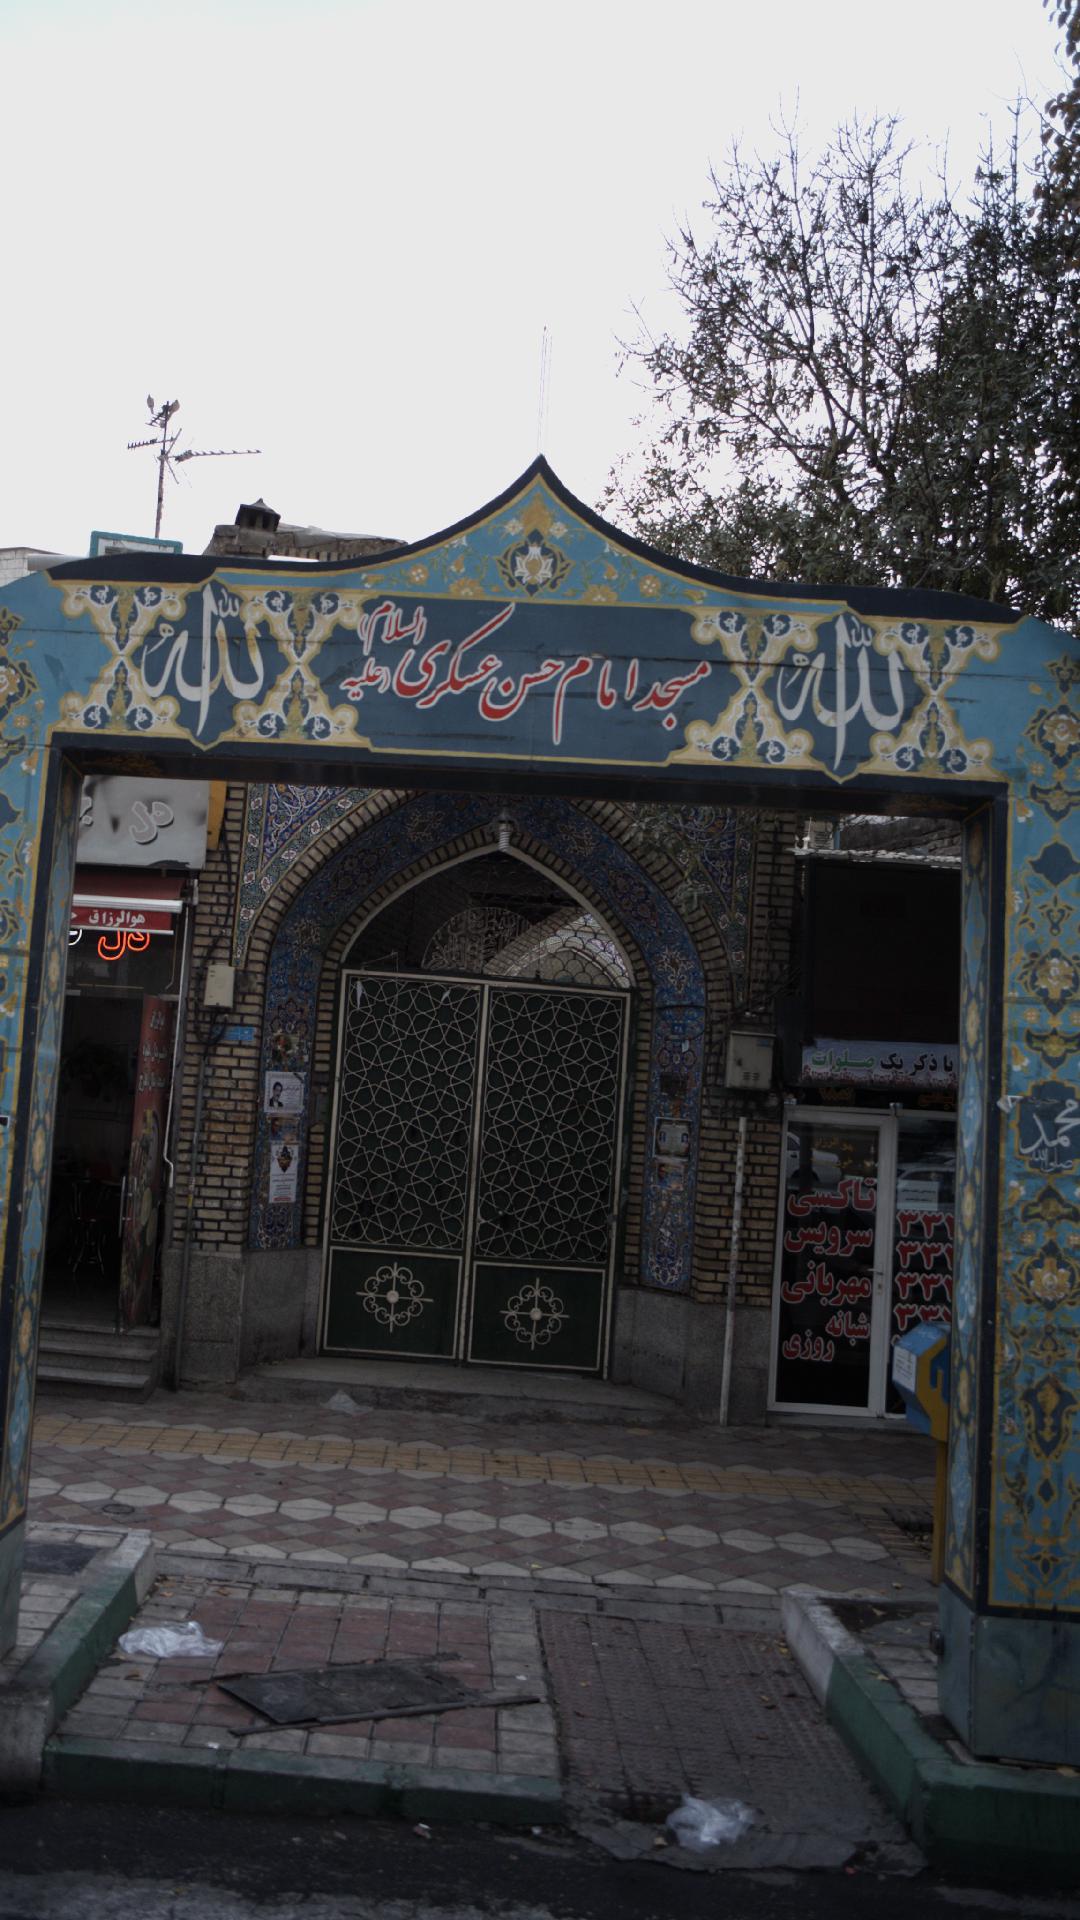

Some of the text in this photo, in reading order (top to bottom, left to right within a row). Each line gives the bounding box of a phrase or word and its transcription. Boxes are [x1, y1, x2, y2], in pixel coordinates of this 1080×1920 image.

[393, 601, 517, 709] عسکری
[479, 656, 565, 722] حسن
[552, 655, 639, 746] امام
[632, 660, 711, 731] مسجد
[787, 1177, 877, 1217] تاکسی
[784, 1221, 873, 1257] سرویس
[781, 1260, 871, 1306] مهربانی
[782, 1329, 835, 1362] روزی
[825, 1310, 870, 1346] شبانه
